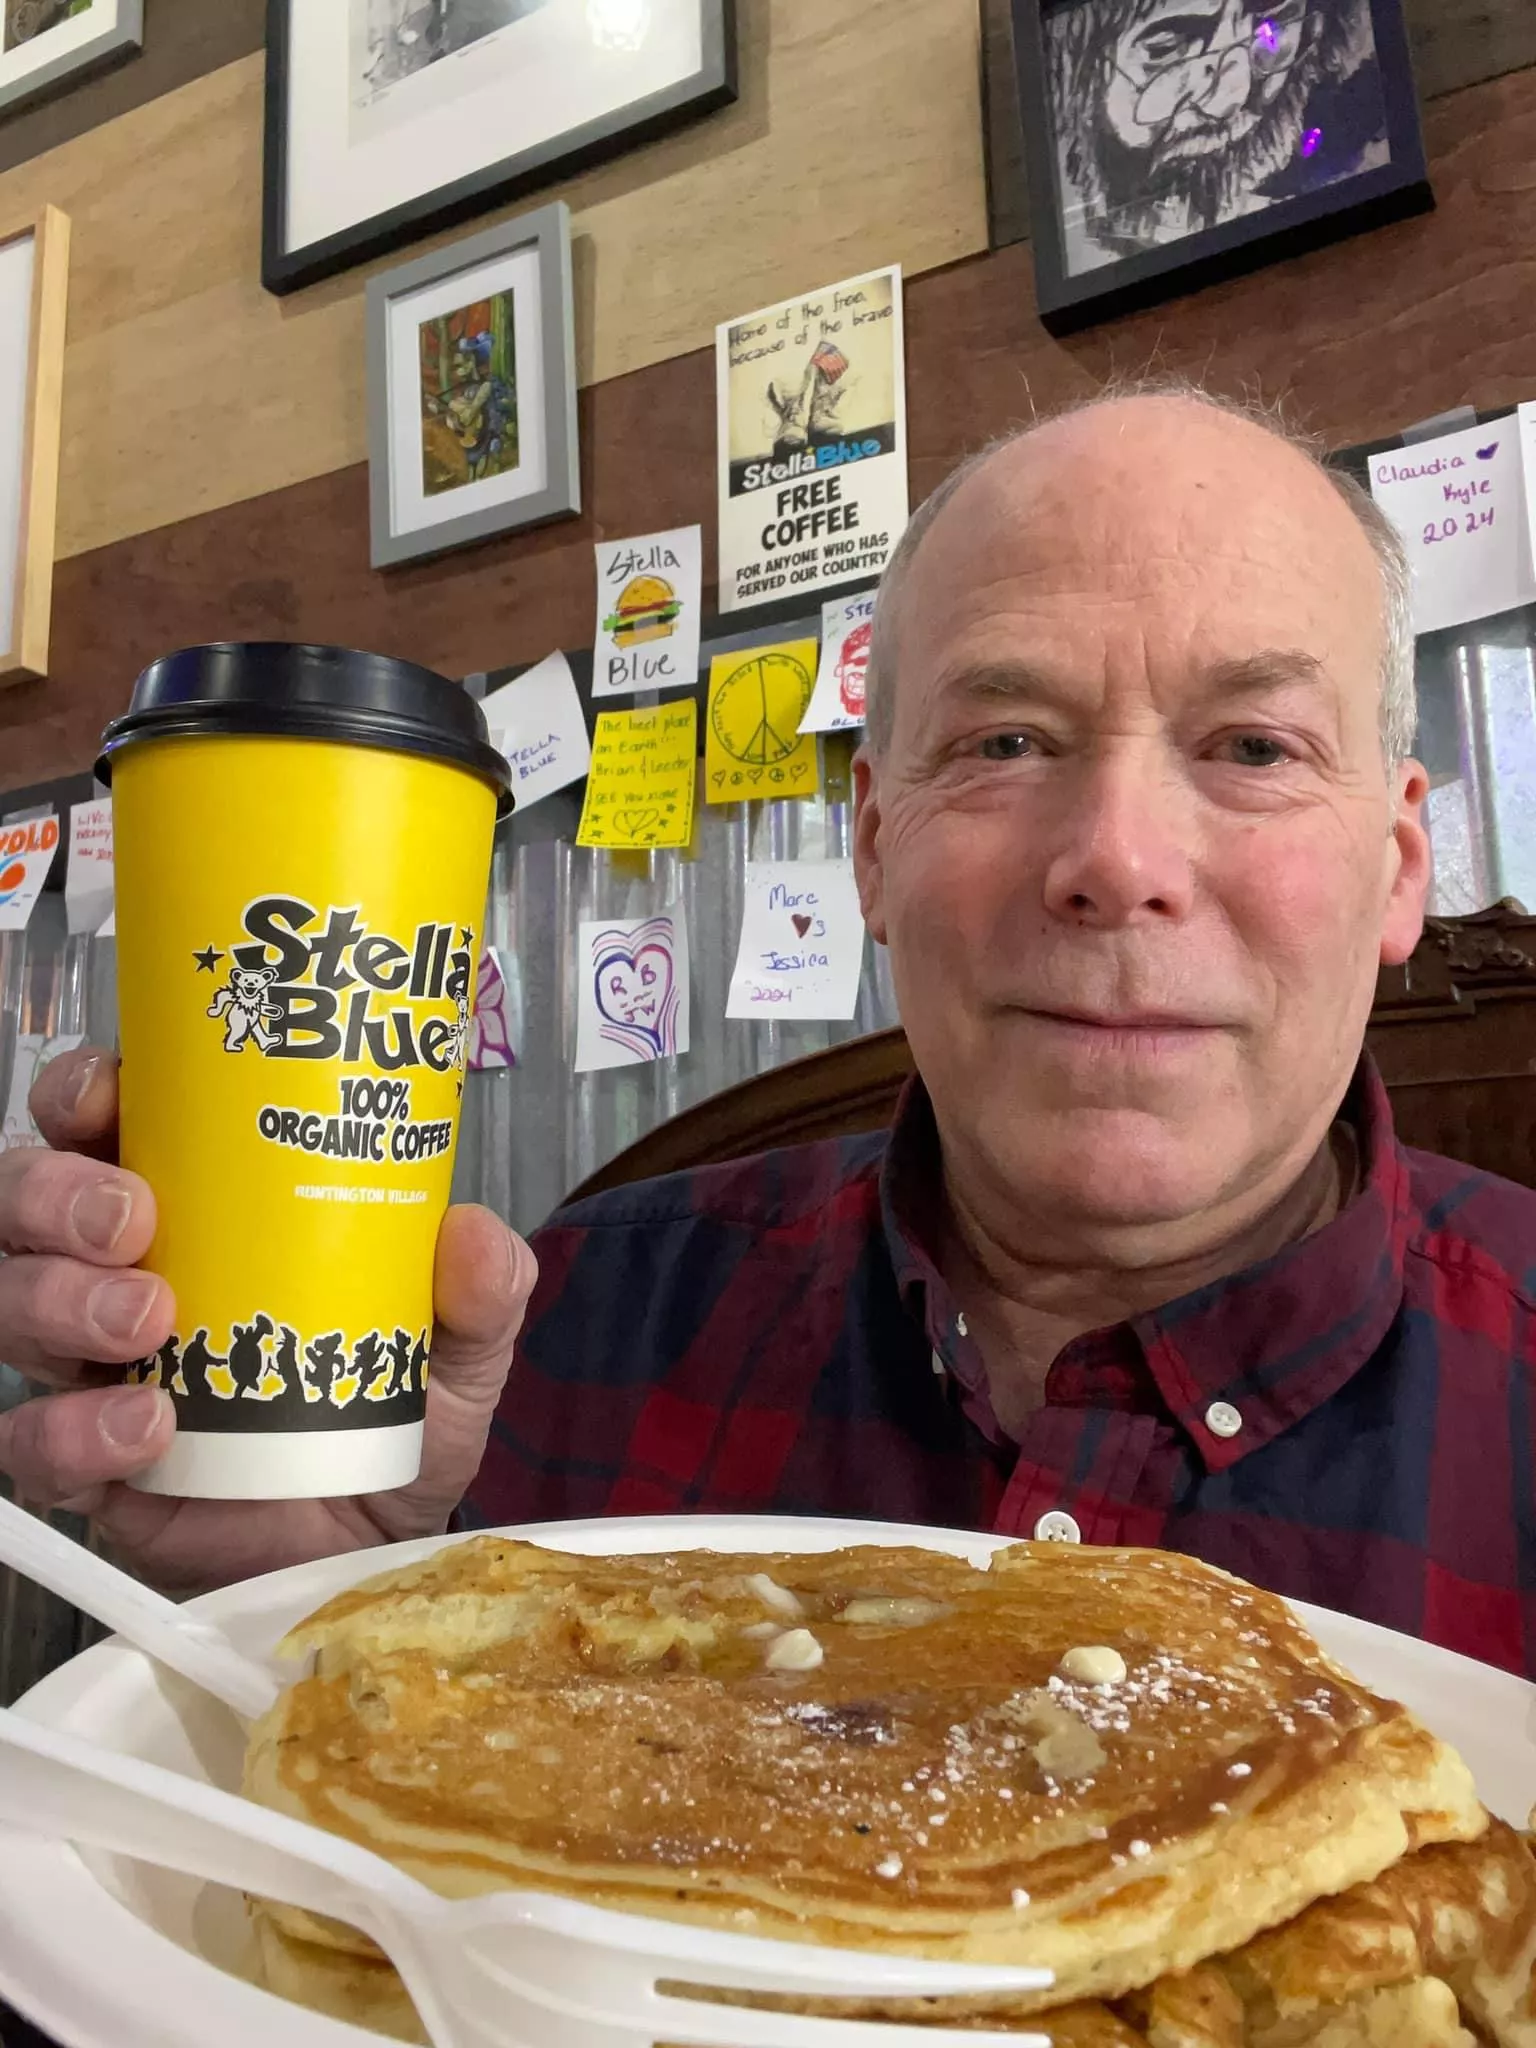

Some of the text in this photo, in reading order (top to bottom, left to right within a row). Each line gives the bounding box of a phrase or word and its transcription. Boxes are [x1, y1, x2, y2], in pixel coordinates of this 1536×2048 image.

[729, 323, 767, 348] Home
[776, 308, 791, 330] of
[802, 303, 823, 320] the
[730, 305, 894, 368] because of the brave
[1377, 455, 1466, 485] Claudia
[777, 474, 842, 518] FREE
[1442, 479, 1493, 505] Kyle
[761, 501, 860, 551] COFFEE
[1422, 507, 1495, 544] 2024
[607, 544, 681, 584] Stella
[736, 531, 889, 583] FOR ANYONE WHO HAS
[737, 550, 889, 599] SERVED OUR COUNTRY
[608, 653, 676, 685] Blue
[505, 733, 561, 765] TELLA
[519, 752, 557, 779] BLUE
[769, 884, 819, 910] Marc
[231, 895, 472, 1001] Stella
[760, 951, 829, 971] Jessica
[750, 987, 793, 1002] 2024
[265, 985, 456, 1073] Blue
[341, 1077, 410, 1121] 100%
[258, 1108, 452, 1162] ORGANIC COFFEE
[294, 1185, 385, 1204] HUNTINGTON
